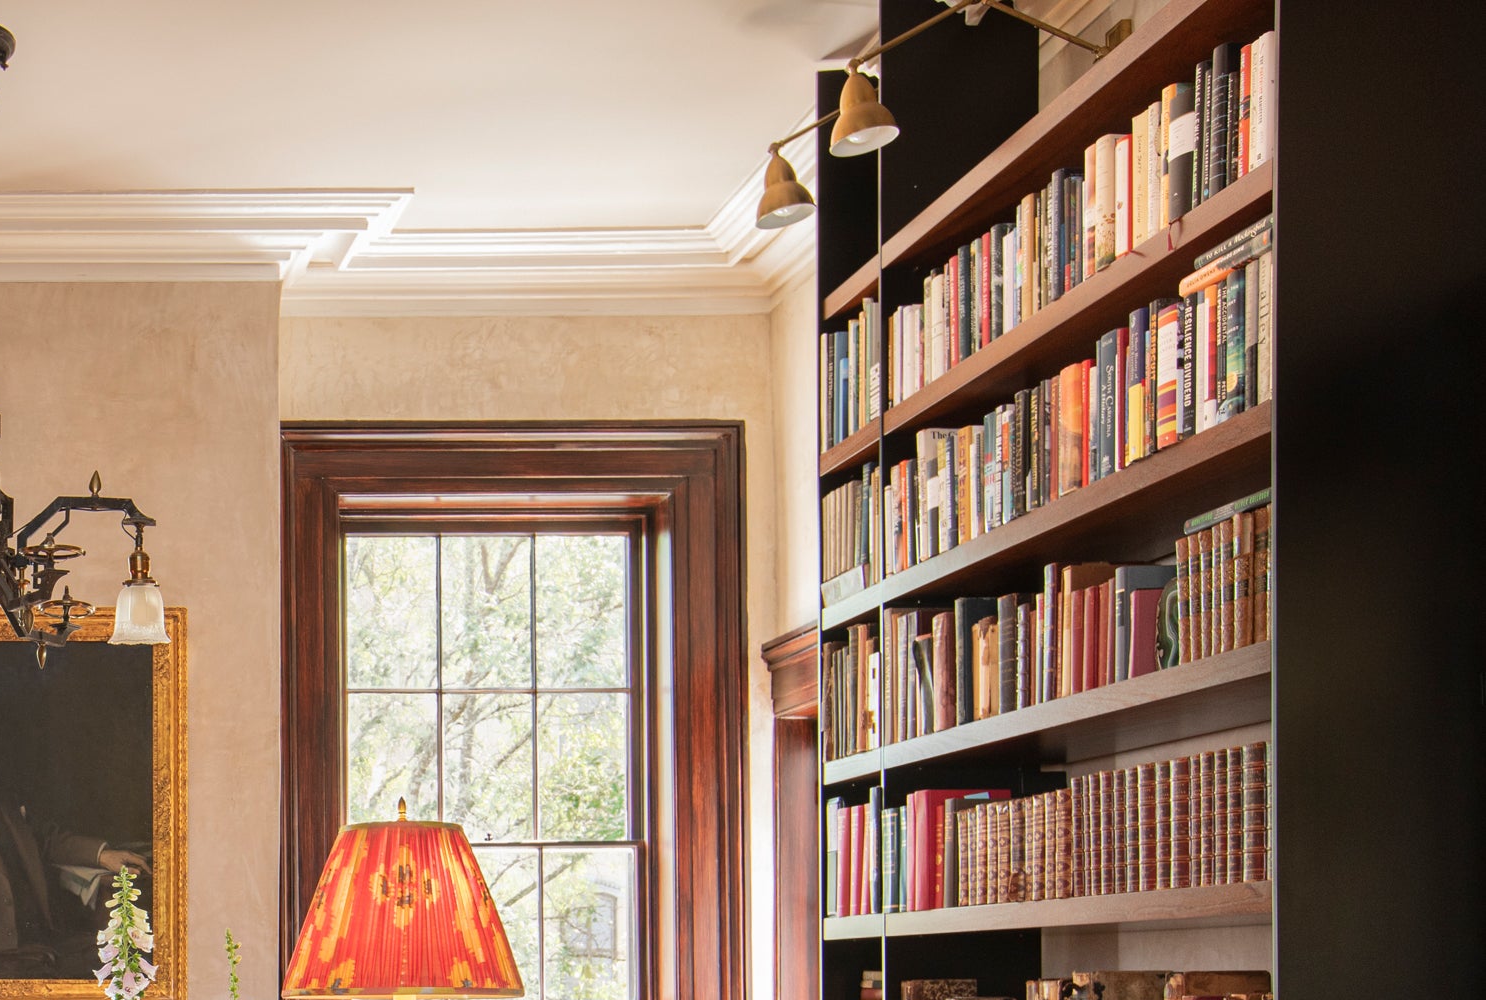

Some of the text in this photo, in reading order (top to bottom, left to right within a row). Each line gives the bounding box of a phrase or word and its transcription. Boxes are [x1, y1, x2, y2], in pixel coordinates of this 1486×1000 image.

[1183, 306, 1193, 407] RESILIENCE DIVIDEND
[1105, 365, 1114, 438] SOUTH CAROLINA
[932, 432, 947, 440] The
[1015, 433, 1023, 476] FONDA
